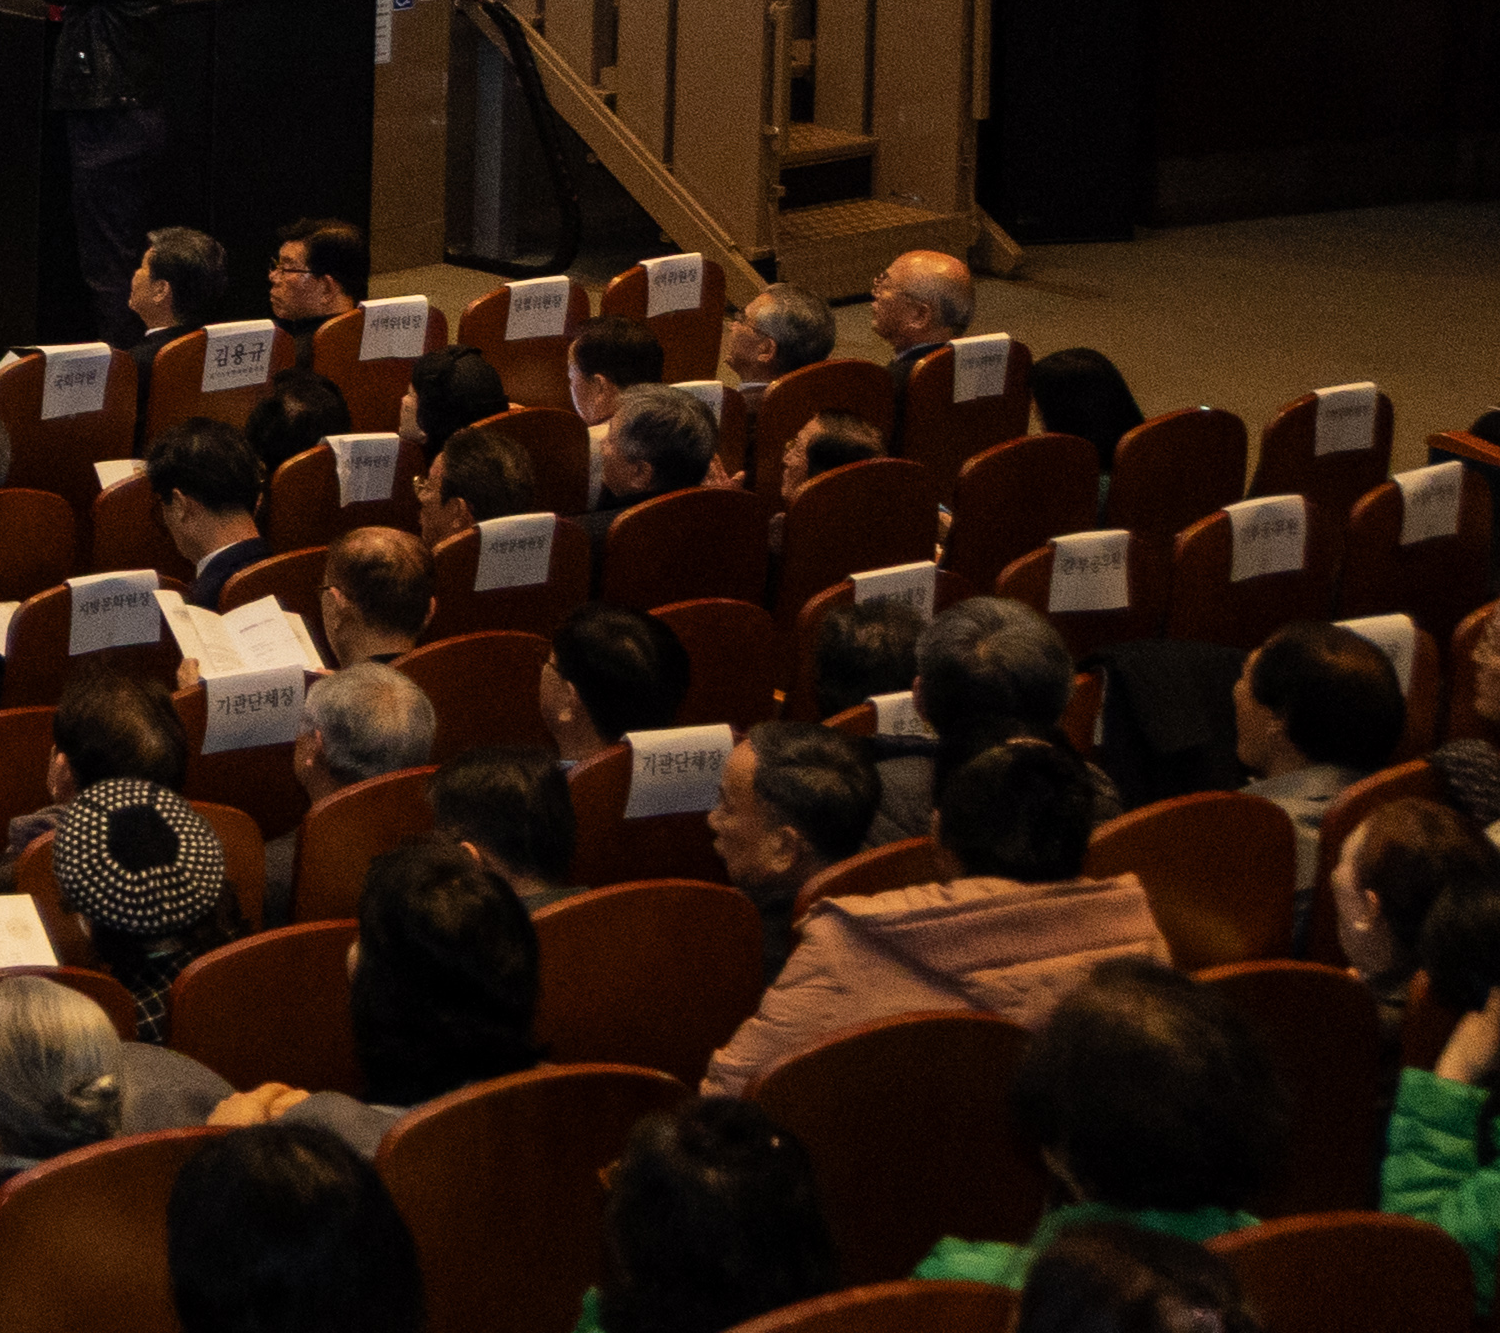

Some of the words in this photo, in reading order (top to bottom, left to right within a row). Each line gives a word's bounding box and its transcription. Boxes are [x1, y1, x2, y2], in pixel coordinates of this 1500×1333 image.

[215, 341, 266, 367] 김용규
[217, 686, 295, 716] 기관단체장
[642, 748, 722, 777] 기관단체장
